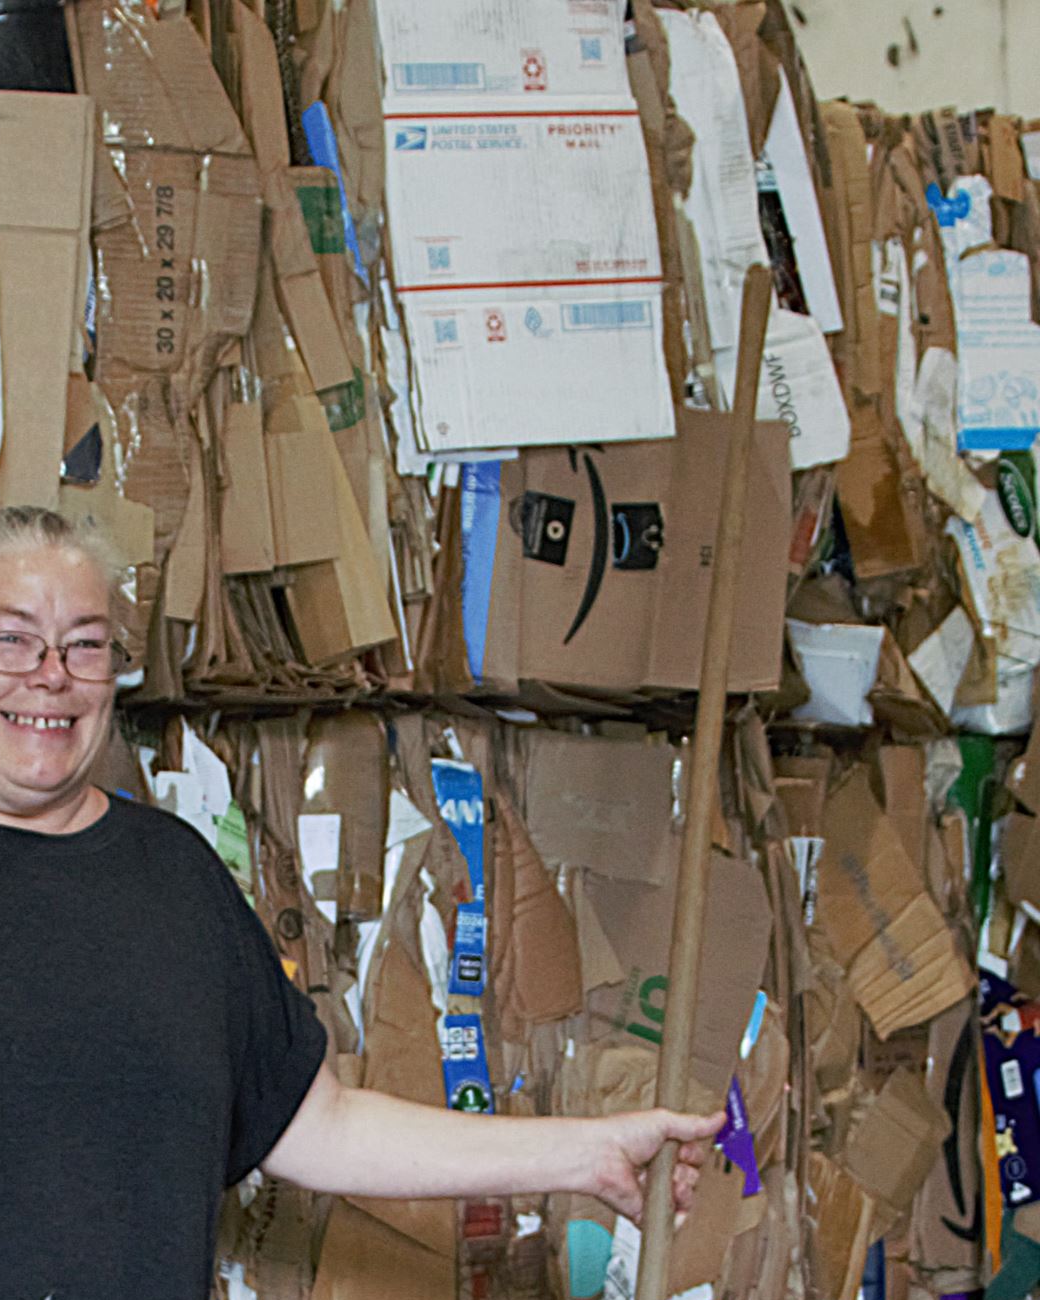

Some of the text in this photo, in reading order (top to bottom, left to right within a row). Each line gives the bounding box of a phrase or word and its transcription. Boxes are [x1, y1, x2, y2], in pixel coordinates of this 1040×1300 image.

[478, 124, 517, 135] STATES
[548, 123, 616, 135] PRIORITY
[432, 139, 524, 151] POSTAL SERVICE
[565, 139, 601, 149] MAIL
[155, 185, 175, 353] 30 x 20 x 29 7/8
